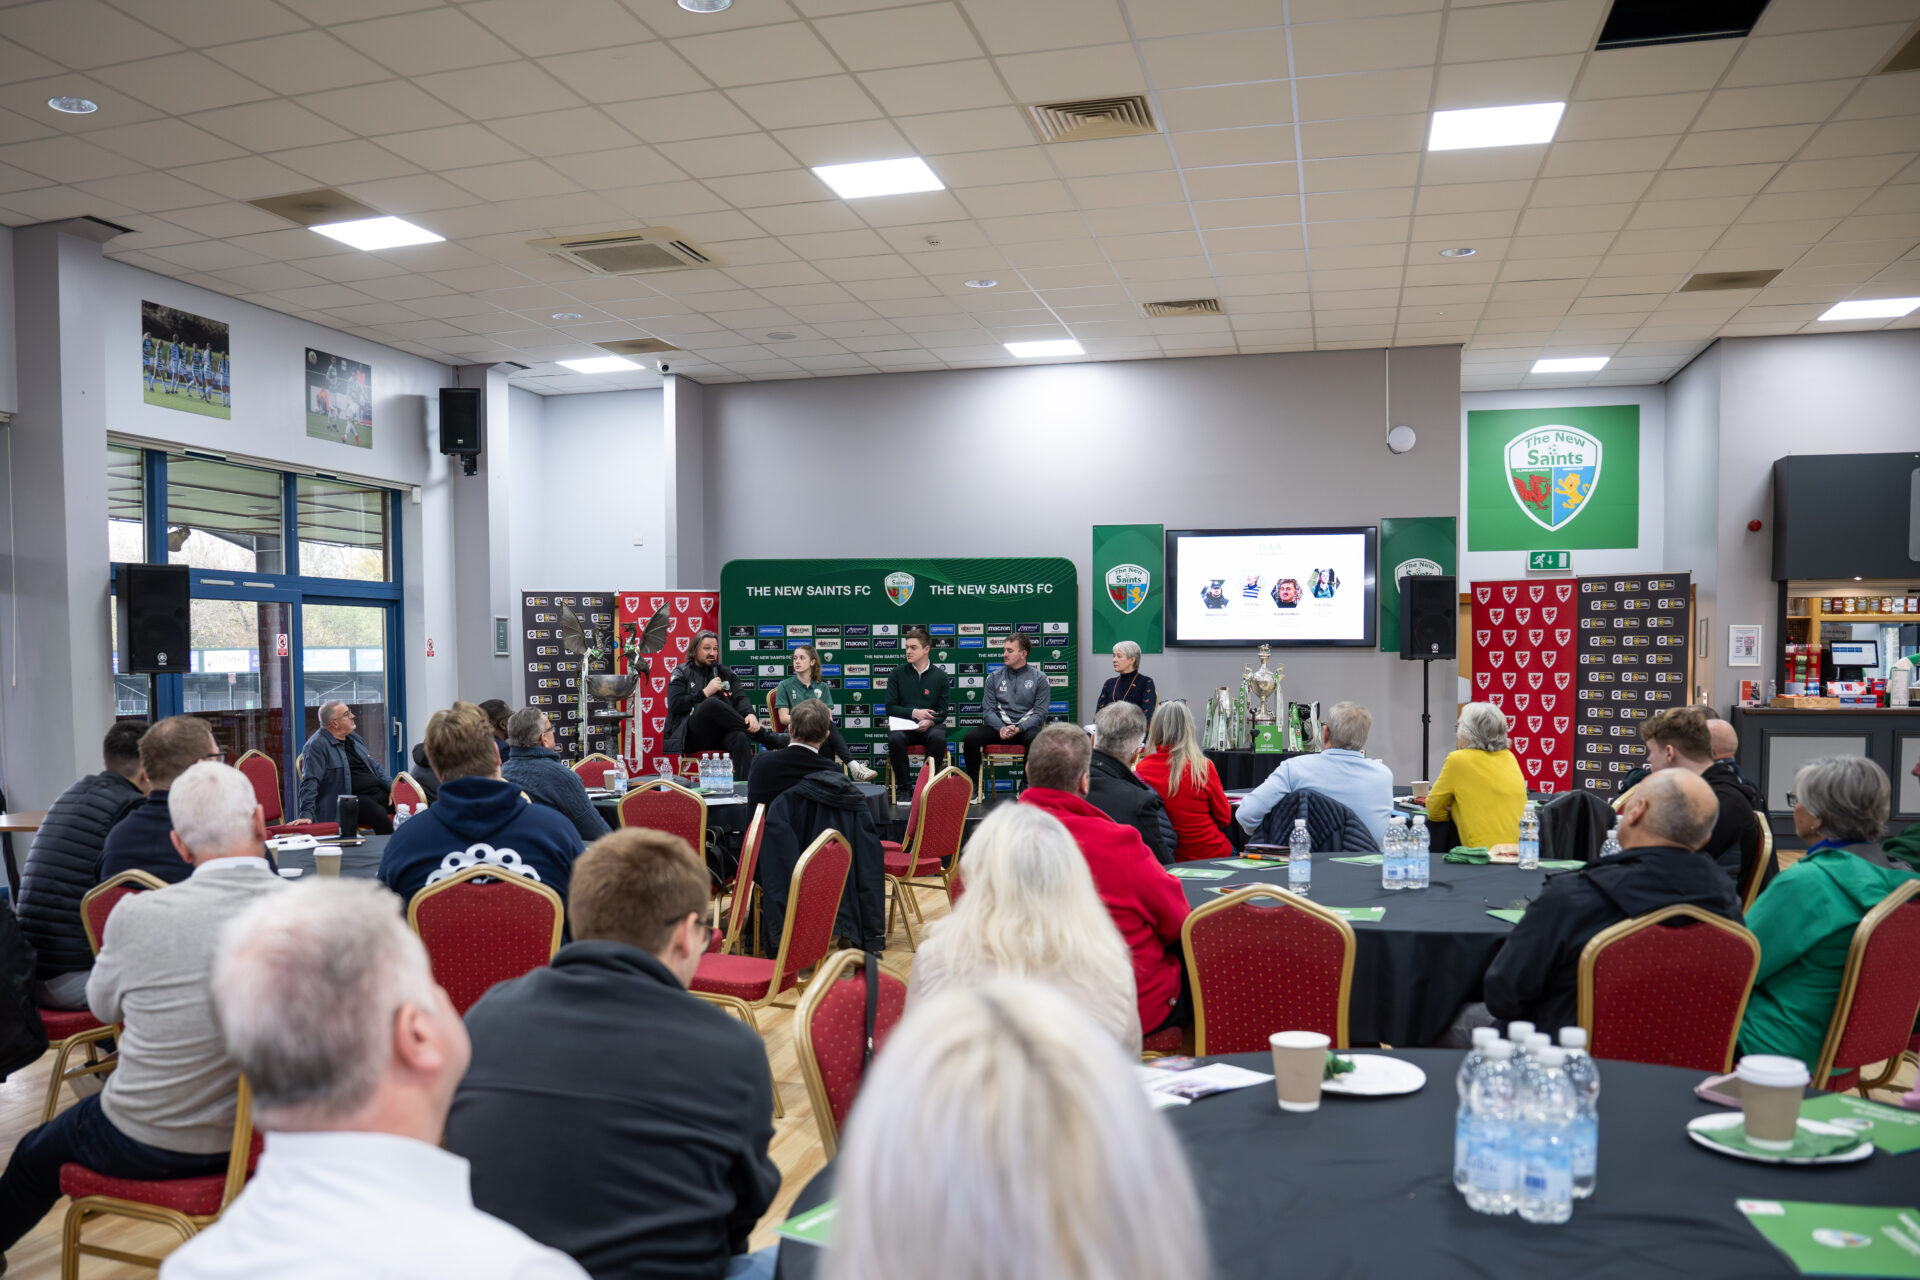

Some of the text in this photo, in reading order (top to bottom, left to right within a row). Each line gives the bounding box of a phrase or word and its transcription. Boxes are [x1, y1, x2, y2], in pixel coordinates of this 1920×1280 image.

[1524, 432, 1586, 449] The New
[1527, 449, 1584, 466] Saints
[1116, 575, 1142, 584] Saints
[746, 585, 871, 597] THE NEW SAINTS FC
[929, 583, 1053, 595] THE NEW SAINTS FC
